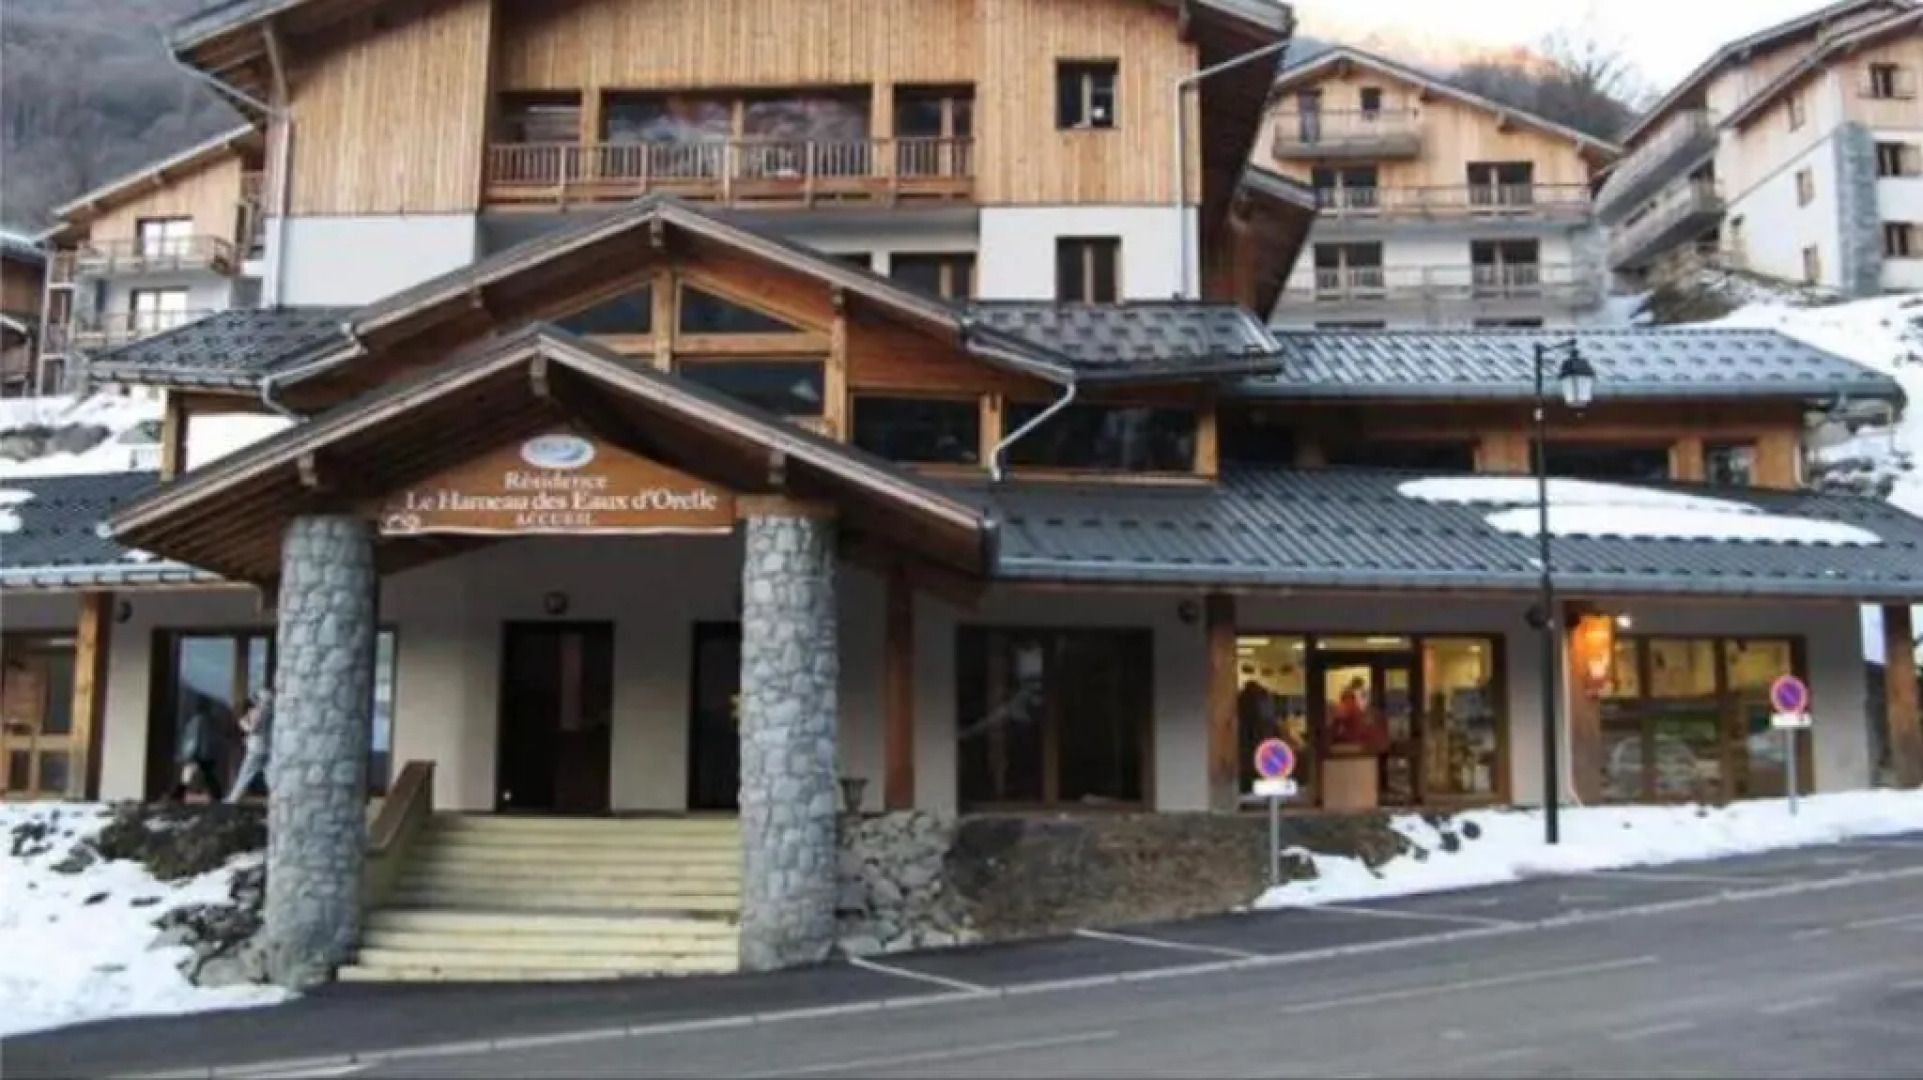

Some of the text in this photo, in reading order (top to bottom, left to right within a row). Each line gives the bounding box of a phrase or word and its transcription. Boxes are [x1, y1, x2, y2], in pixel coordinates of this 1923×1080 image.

[406, 491, 431, 510] Le
[439, 490, 528, 509] Hameau
[532, 490, 567, 510] des
[571, 491, 629, 510] Eaux
